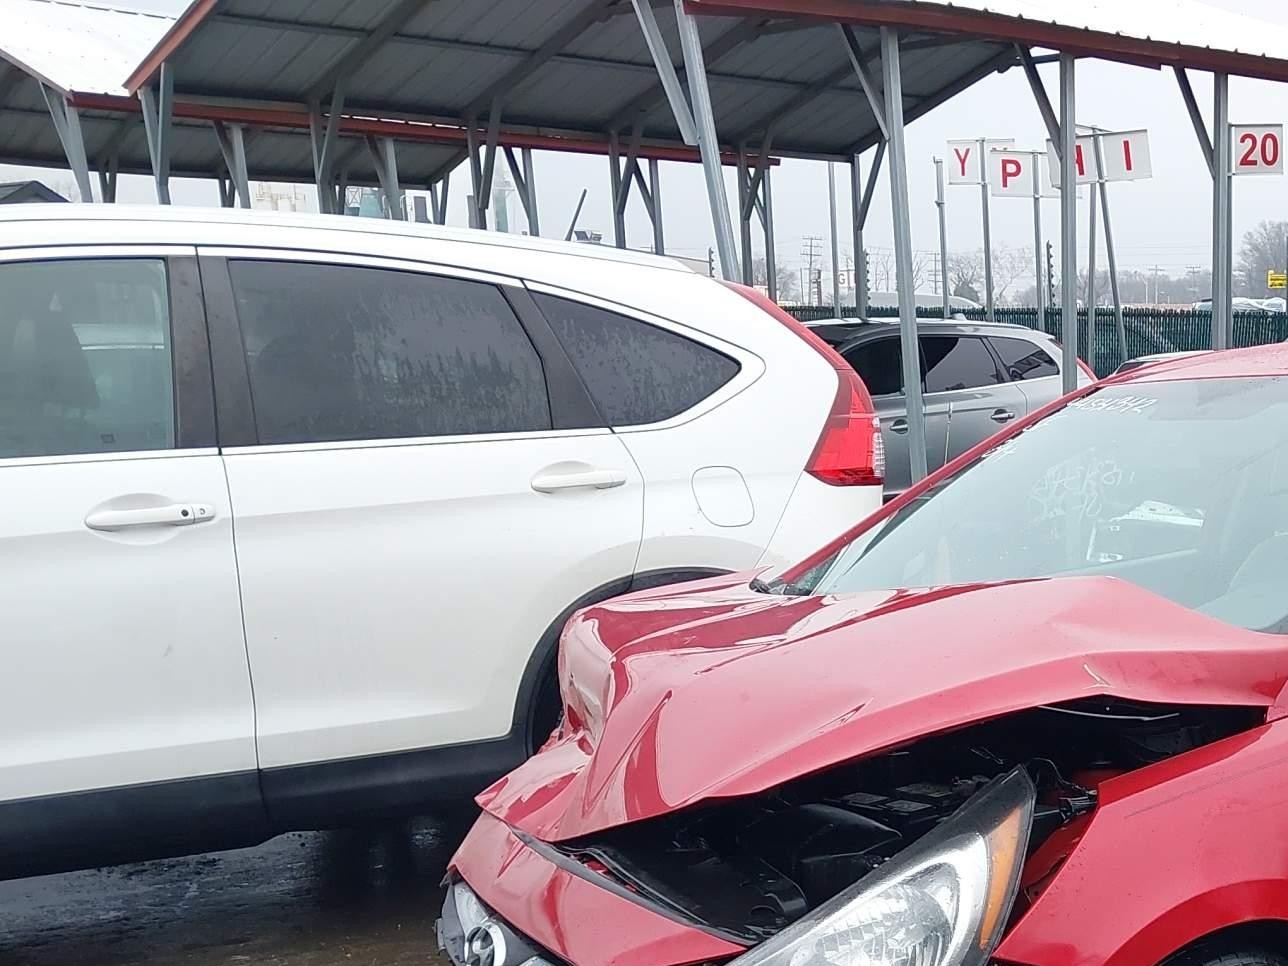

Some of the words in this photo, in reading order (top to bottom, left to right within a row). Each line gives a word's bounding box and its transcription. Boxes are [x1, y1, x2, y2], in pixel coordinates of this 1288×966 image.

[953, 148, 971, 177] Y
[1122, 139, 1133, 171] I
[1239, 132, 1280, 168] 20
[1001, 159, 1022, 188] P
